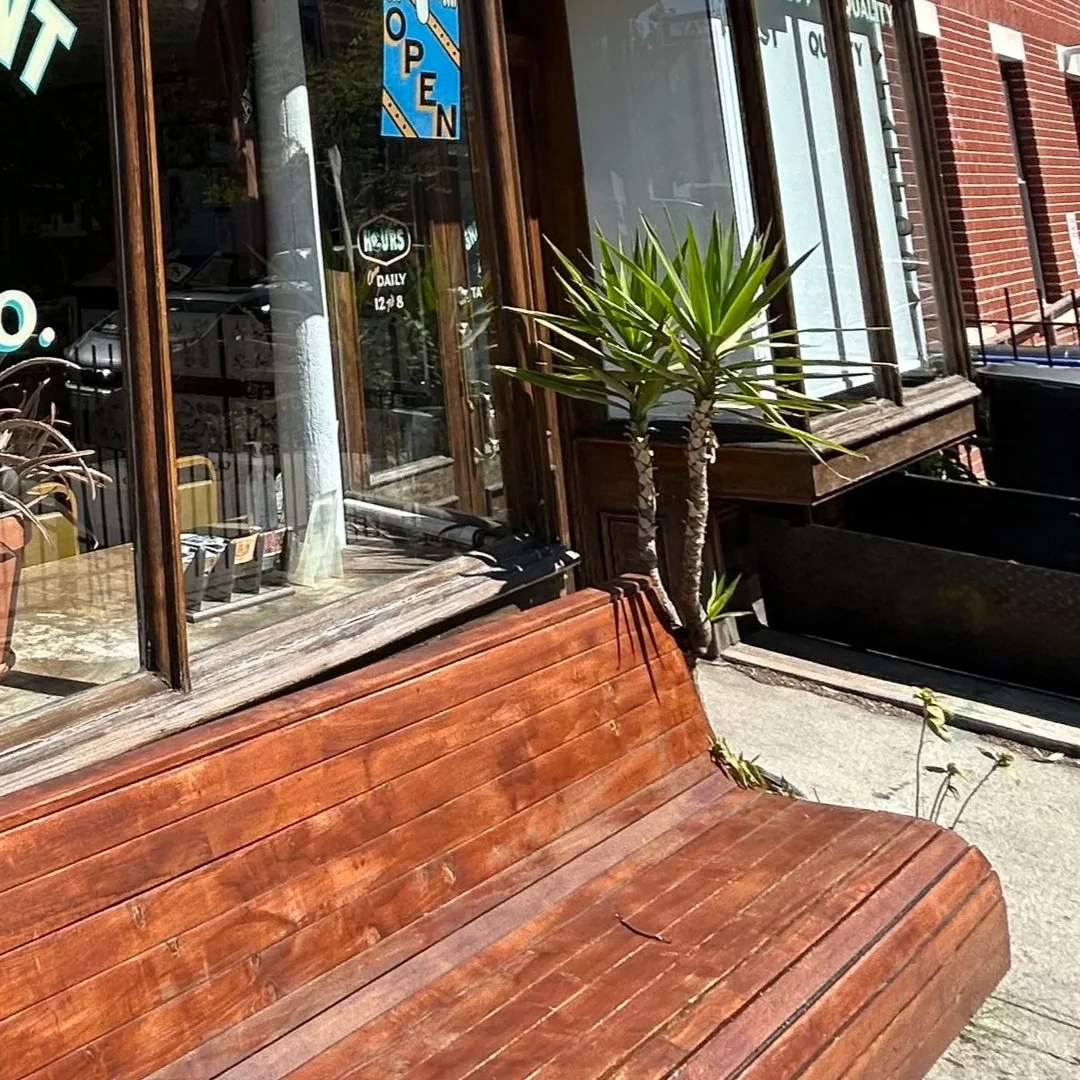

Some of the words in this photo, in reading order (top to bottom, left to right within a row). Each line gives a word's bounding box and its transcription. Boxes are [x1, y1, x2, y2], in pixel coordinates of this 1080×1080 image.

[385, 6, 457, 138] OPEN
[363, 228, 405, 253] HOURS
[376, 272, 407, 288] DAILY
